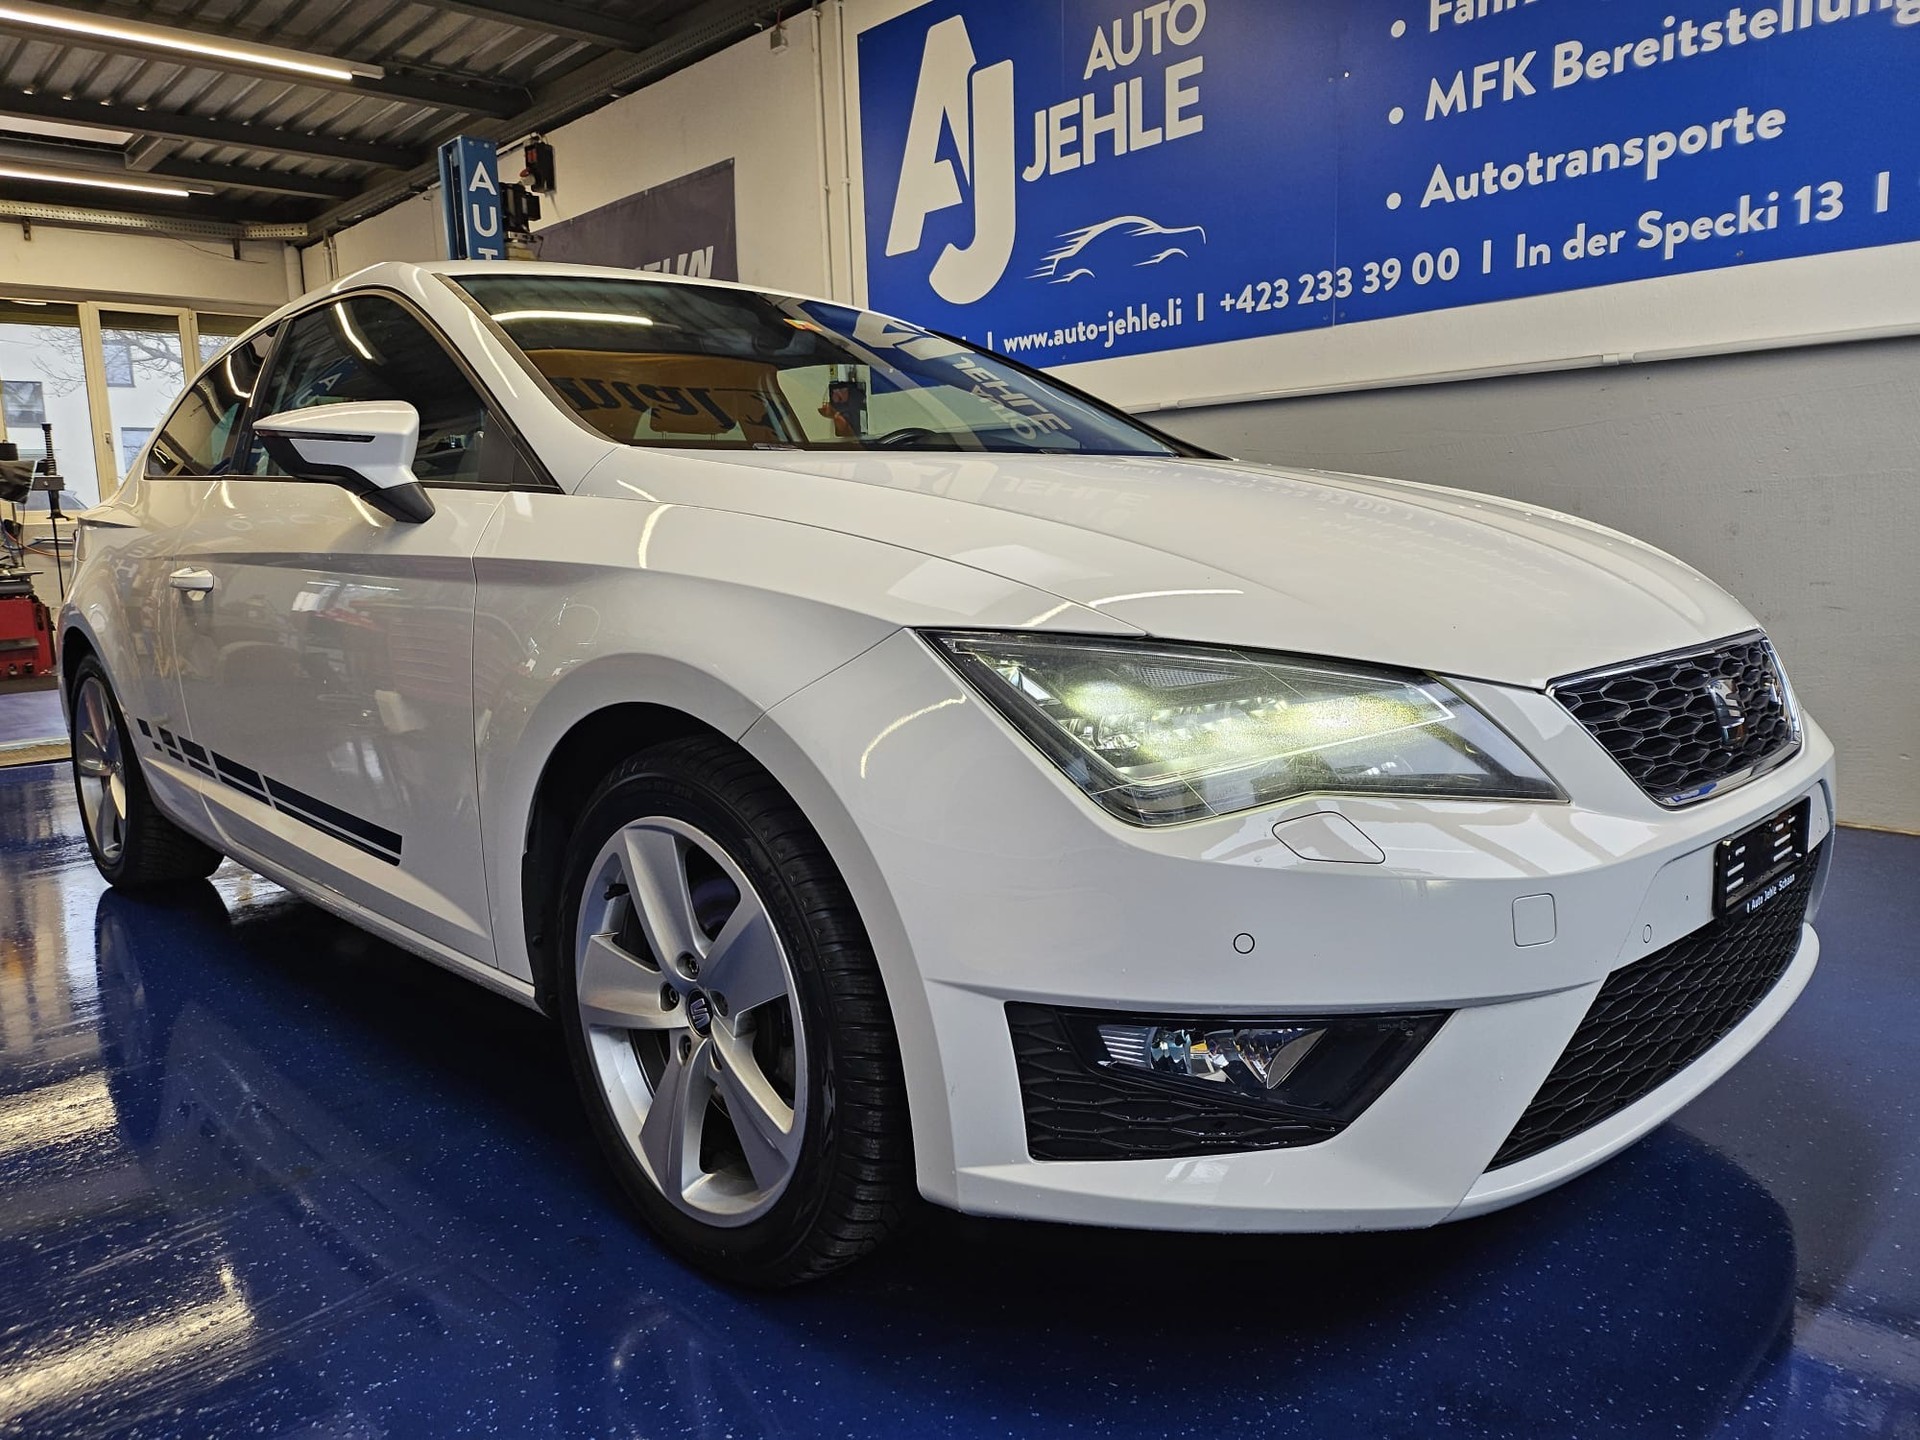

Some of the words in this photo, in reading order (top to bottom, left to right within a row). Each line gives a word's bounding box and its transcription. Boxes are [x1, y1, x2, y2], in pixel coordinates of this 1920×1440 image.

[1083, 0, 1206, 80] AUTO
[1425, 50, 1537, 121] MFK
[886, 14, 1016, 304] AJ
[1022, 56, 1203, 182] JEHLE
[1420, 106, 1786, 208] Autotransporte
[1003, 298, 1182, 354] www.auto-jehle.li
[1220, 278, 1290, 314] +423
[1298, 267, 1353, 305] 233
[1362, 258, 1402, 294] 39
[1412, 247, 1460, 285] 00
[1516, 234, 1551, 268] In
[1563, 222, 1626, 261] der
[1637, 190, 1779, 260] Specki
[1794, 180, 1844, 224] 13
